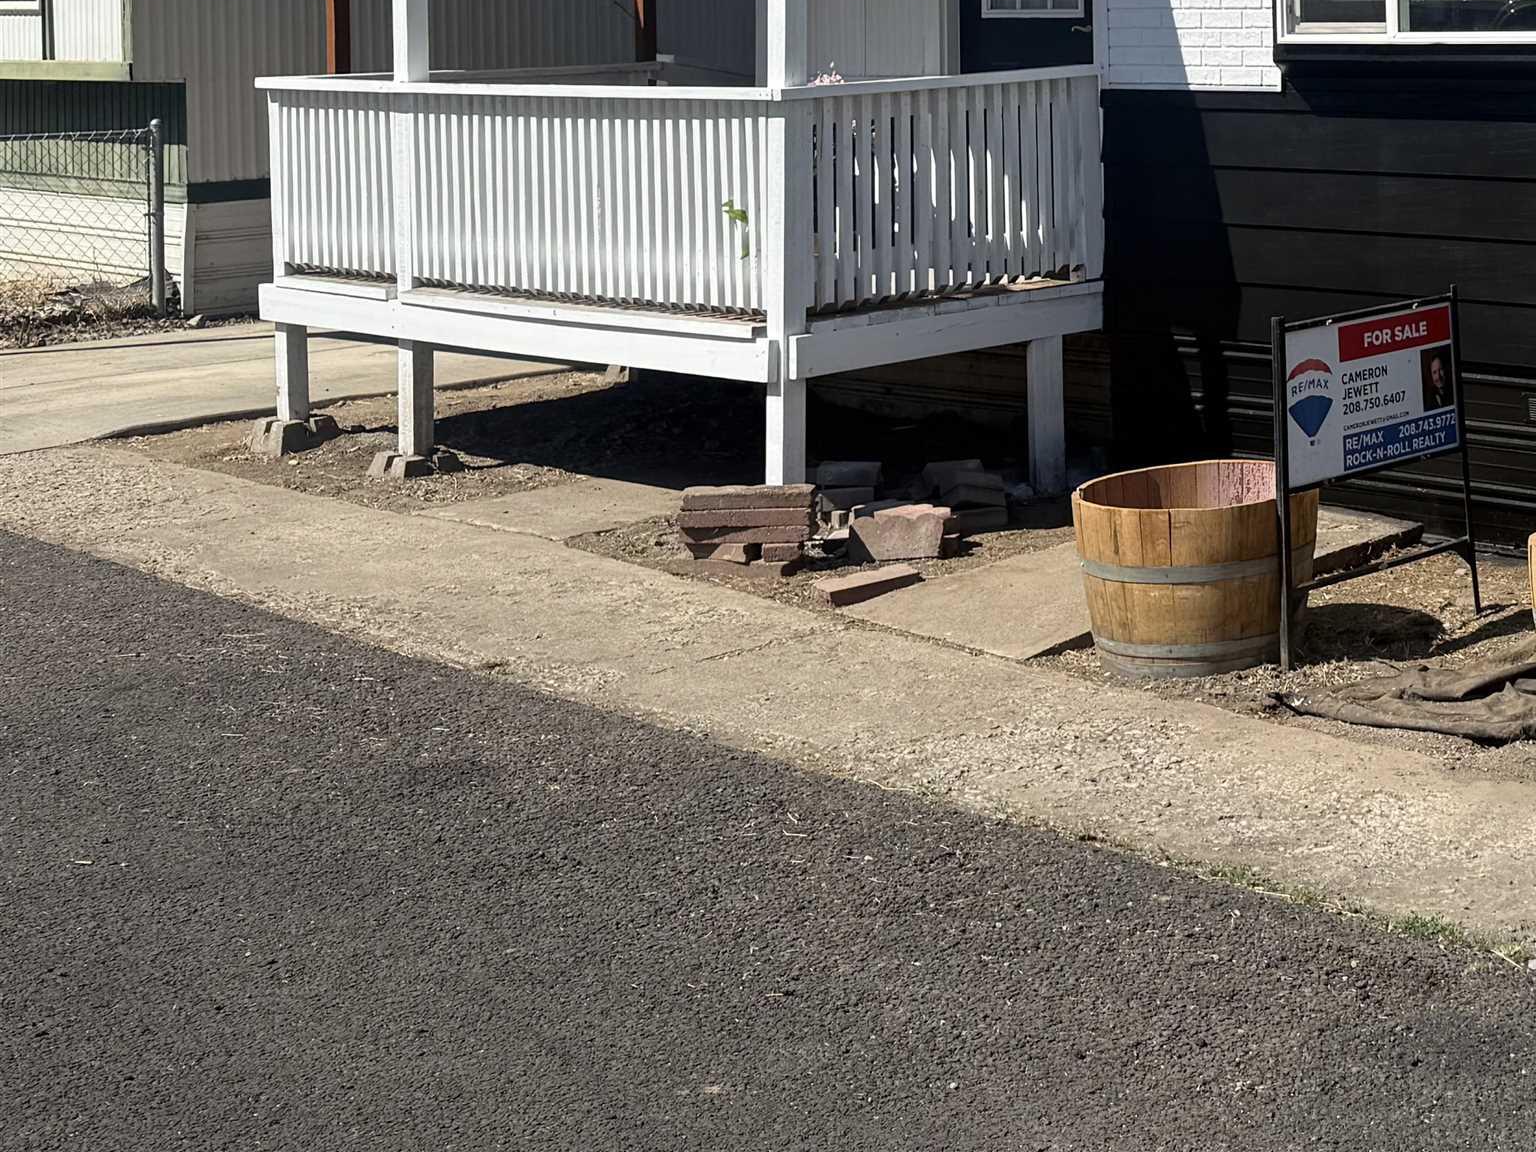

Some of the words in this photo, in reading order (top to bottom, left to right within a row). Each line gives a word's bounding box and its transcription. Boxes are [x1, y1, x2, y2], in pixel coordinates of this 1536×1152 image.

[1363, 328, 1392, 348] FOR
[1394, 321, 1428, 341] SALE
[1341, 365, 1388, 385] CAMERON
[1291, 378, 1329, 398] RE/MAX
[1342, 381, 1380, 401] JEWETT
[1342, 390, 1406, 415] 208.750.6407
[1345, 431, 1384, 451] RE/MAX
[1346, 441, 1411, 467] ROCK-N-ROLL
[1412, 431, 1446, 450] REALTY
